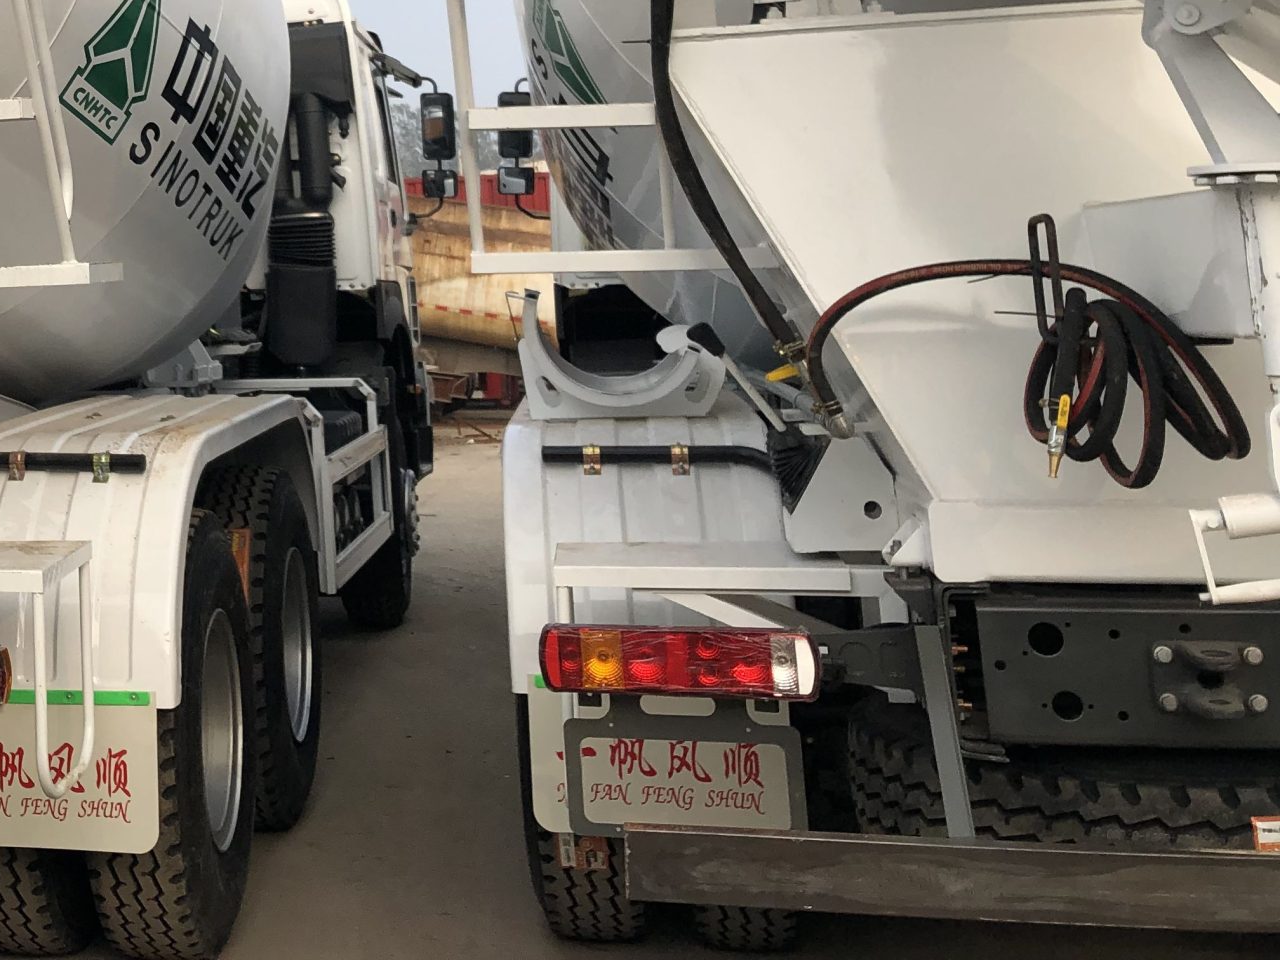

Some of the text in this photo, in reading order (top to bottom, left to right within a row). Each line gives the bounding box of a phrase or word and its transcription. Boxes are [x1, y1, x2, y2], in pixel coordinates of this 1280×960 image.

[72, 87, 119, 130] CNHTC
[128, 121, 244, 261] SINOTRUK
[20, 796, 69, 822] FENG
[77, 797, 132, 824] SHUN
[590, 782, 632, 806] FAN
[641, 785, 695, 811] FENG
[704, 788, 766, 816] SHUN
